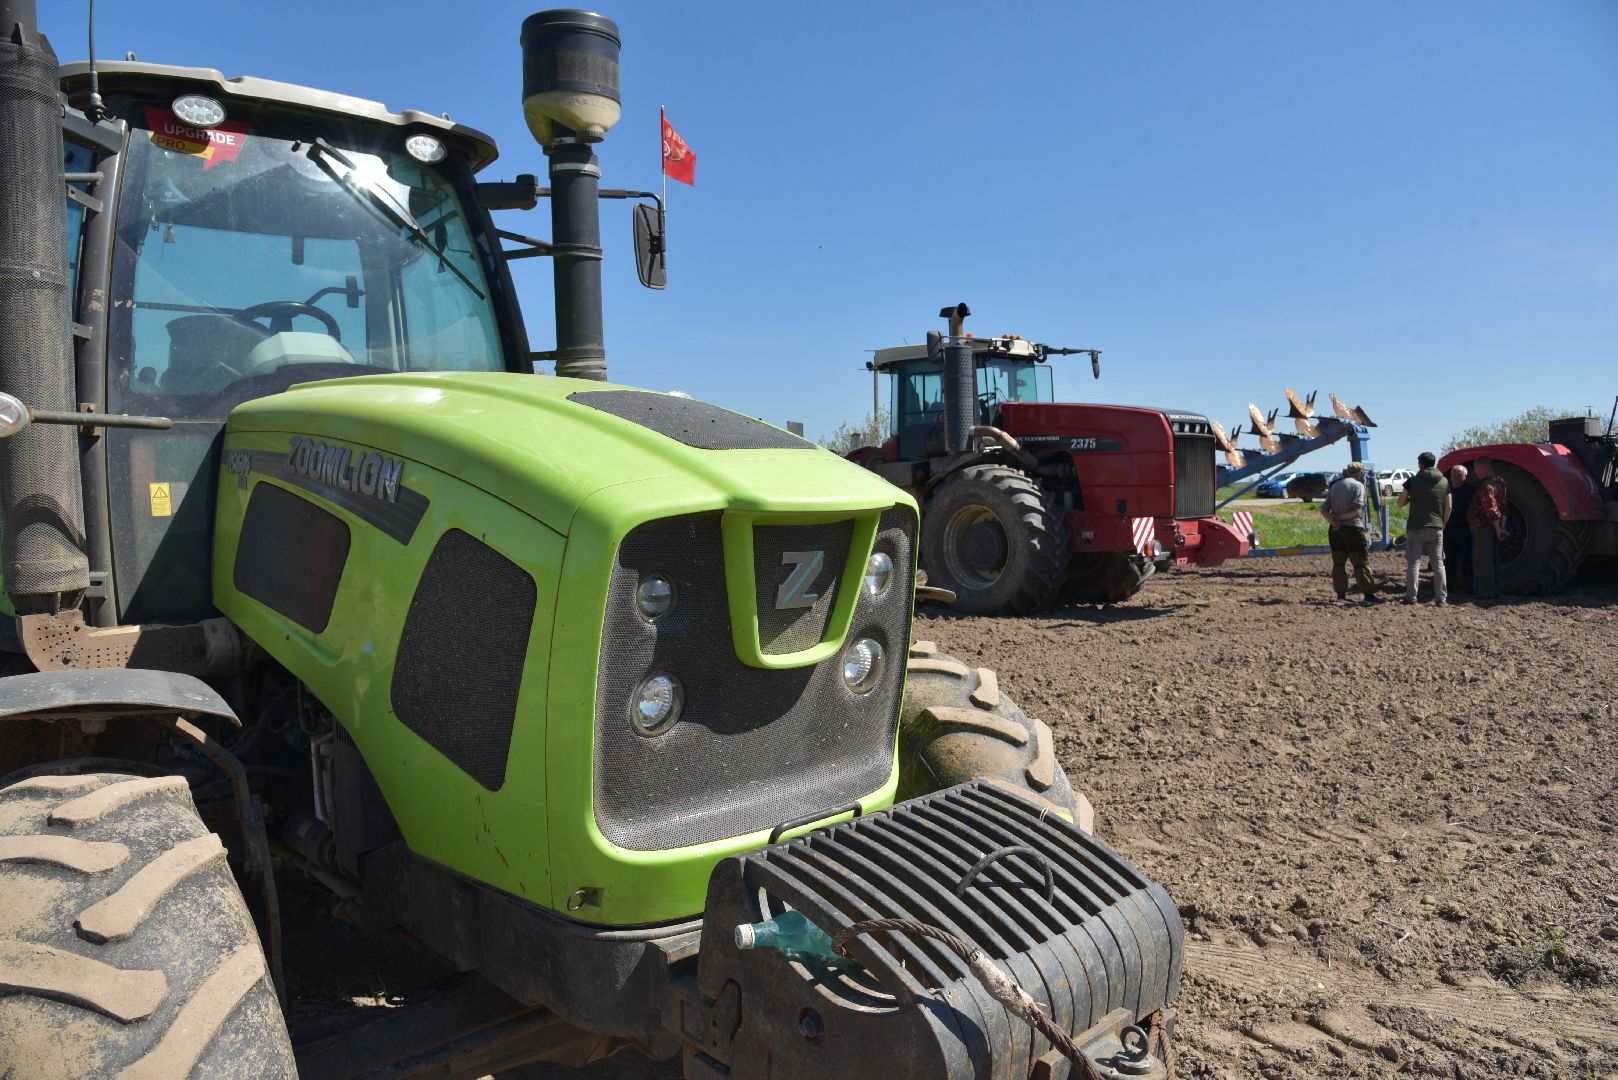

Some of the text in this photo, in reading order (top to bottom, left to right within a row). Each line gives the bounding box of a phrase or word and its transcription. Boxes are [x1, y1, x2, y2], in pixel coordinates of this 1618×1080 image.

[156, 136, 186, 151] PRO
[164, 123, 235, 145] UPGRADE
[1070, 438, 1096, 449] 2375
[286, 436, 405, 503] ZOOMLION
[775, 551, 825, 609] Z
